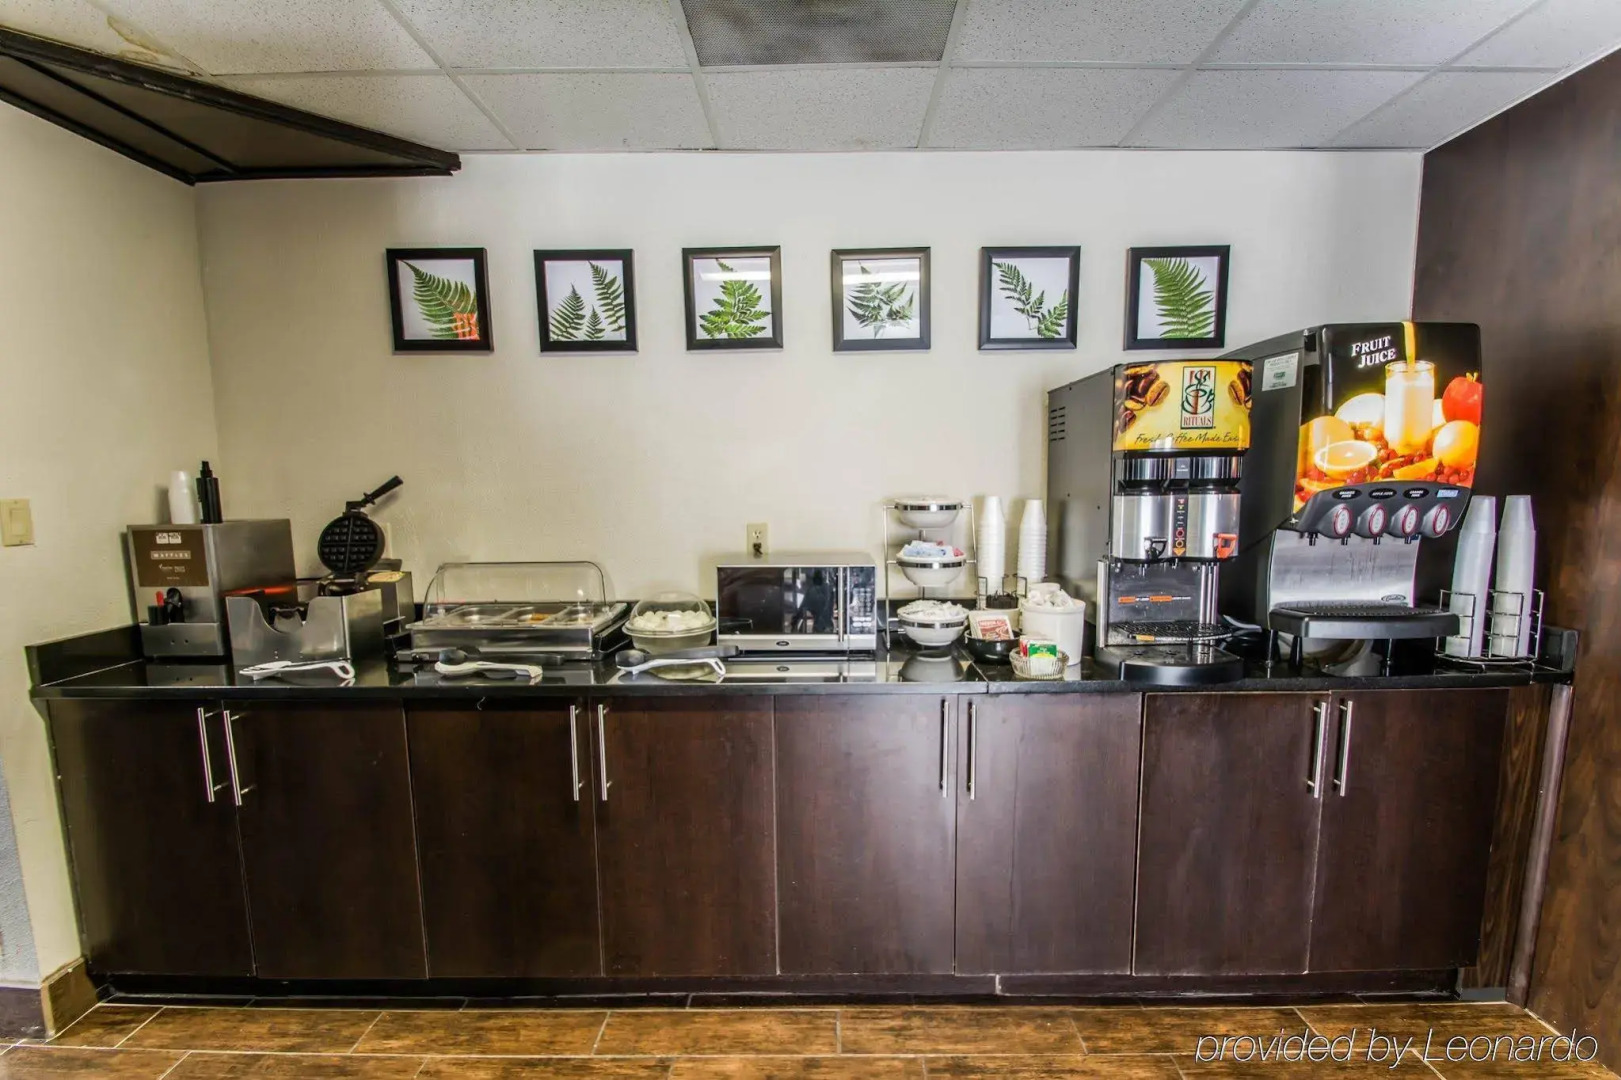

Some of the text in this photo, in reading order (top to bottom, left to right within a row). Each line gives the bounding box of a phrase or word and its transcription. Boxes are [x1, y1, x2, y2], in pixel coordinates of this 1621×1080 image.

[1351, 336, 1391, 357] FRUIT
[1358, 348, 1397, 368] JUICE
[1183, 416, 1212, 426] RITUALS
[1195, 431, 1221, 443] Made
